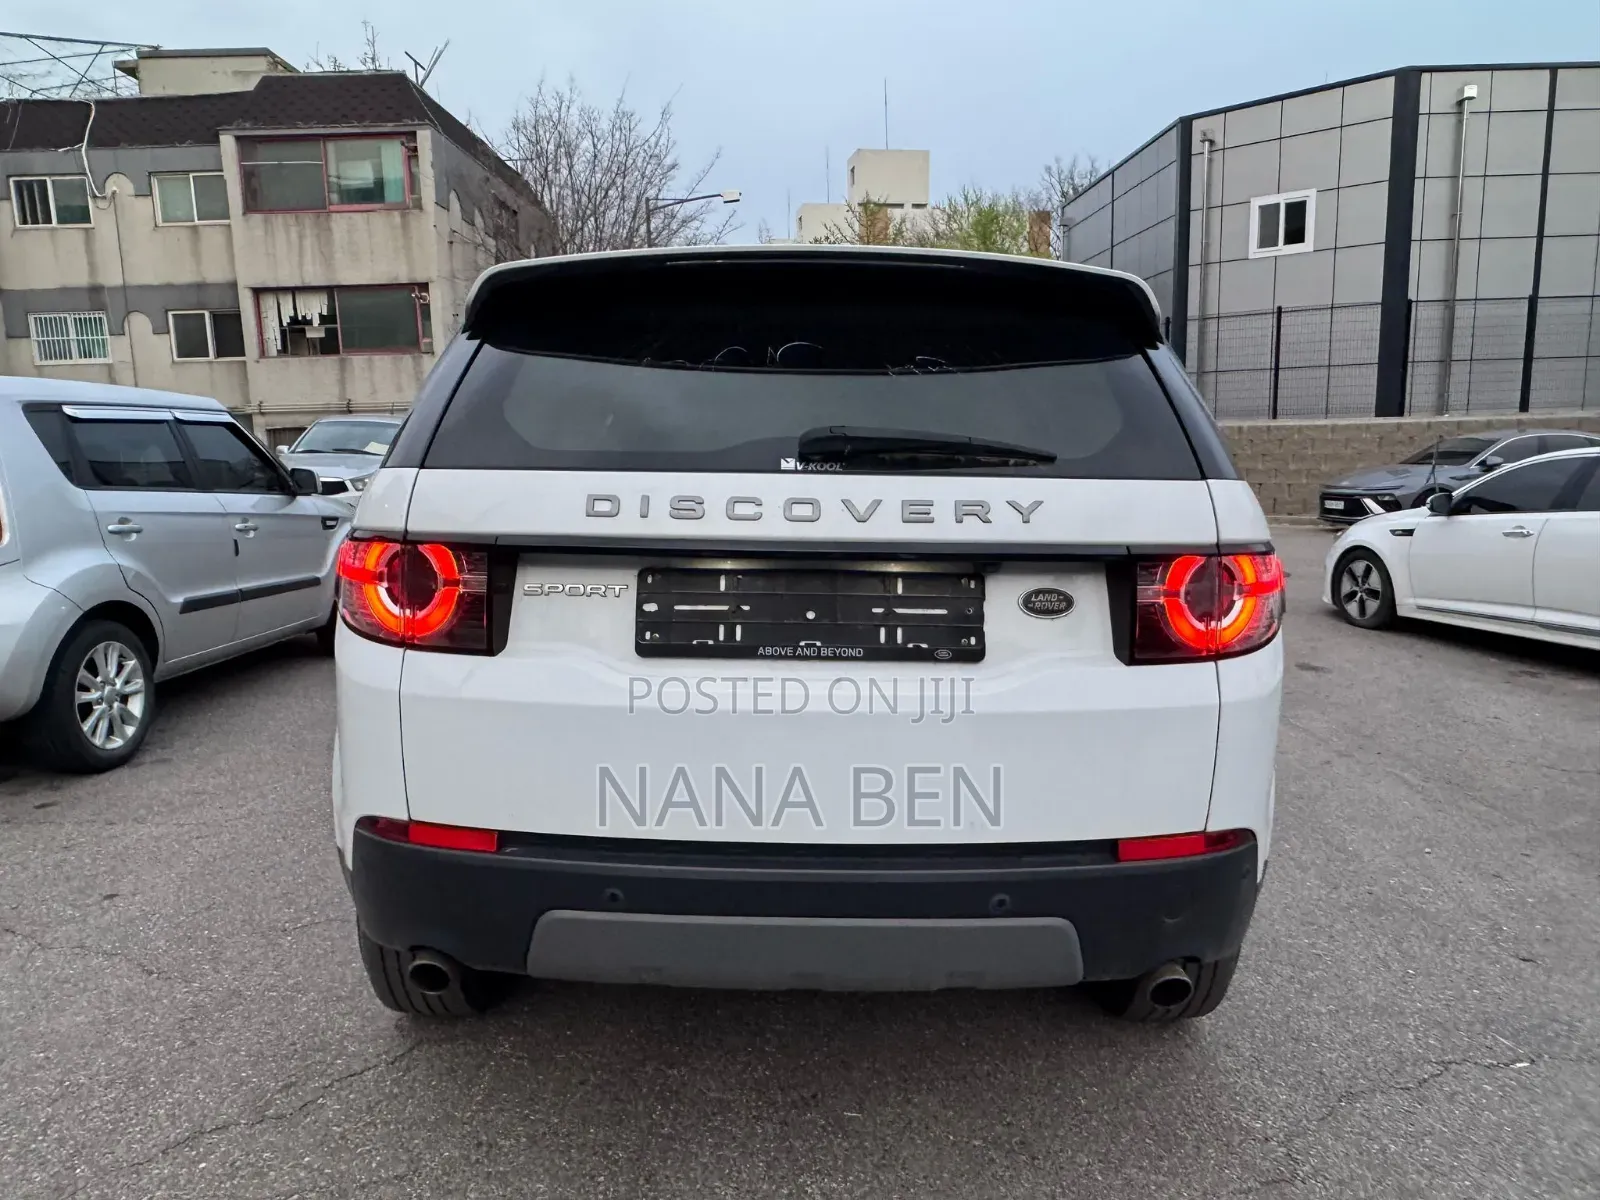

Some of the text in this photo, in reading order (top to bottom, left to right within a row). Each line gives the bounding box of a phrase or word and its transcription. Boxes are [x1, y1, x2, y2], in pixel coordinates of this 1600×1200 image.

[796, 461, 843, 472] V-KOOL
[585, 493, 1044, 524] DISCOVERY
[523, 583, 628, 598] SPORT
[757, 646, 864, 657] ABOVE AND BEYOND
